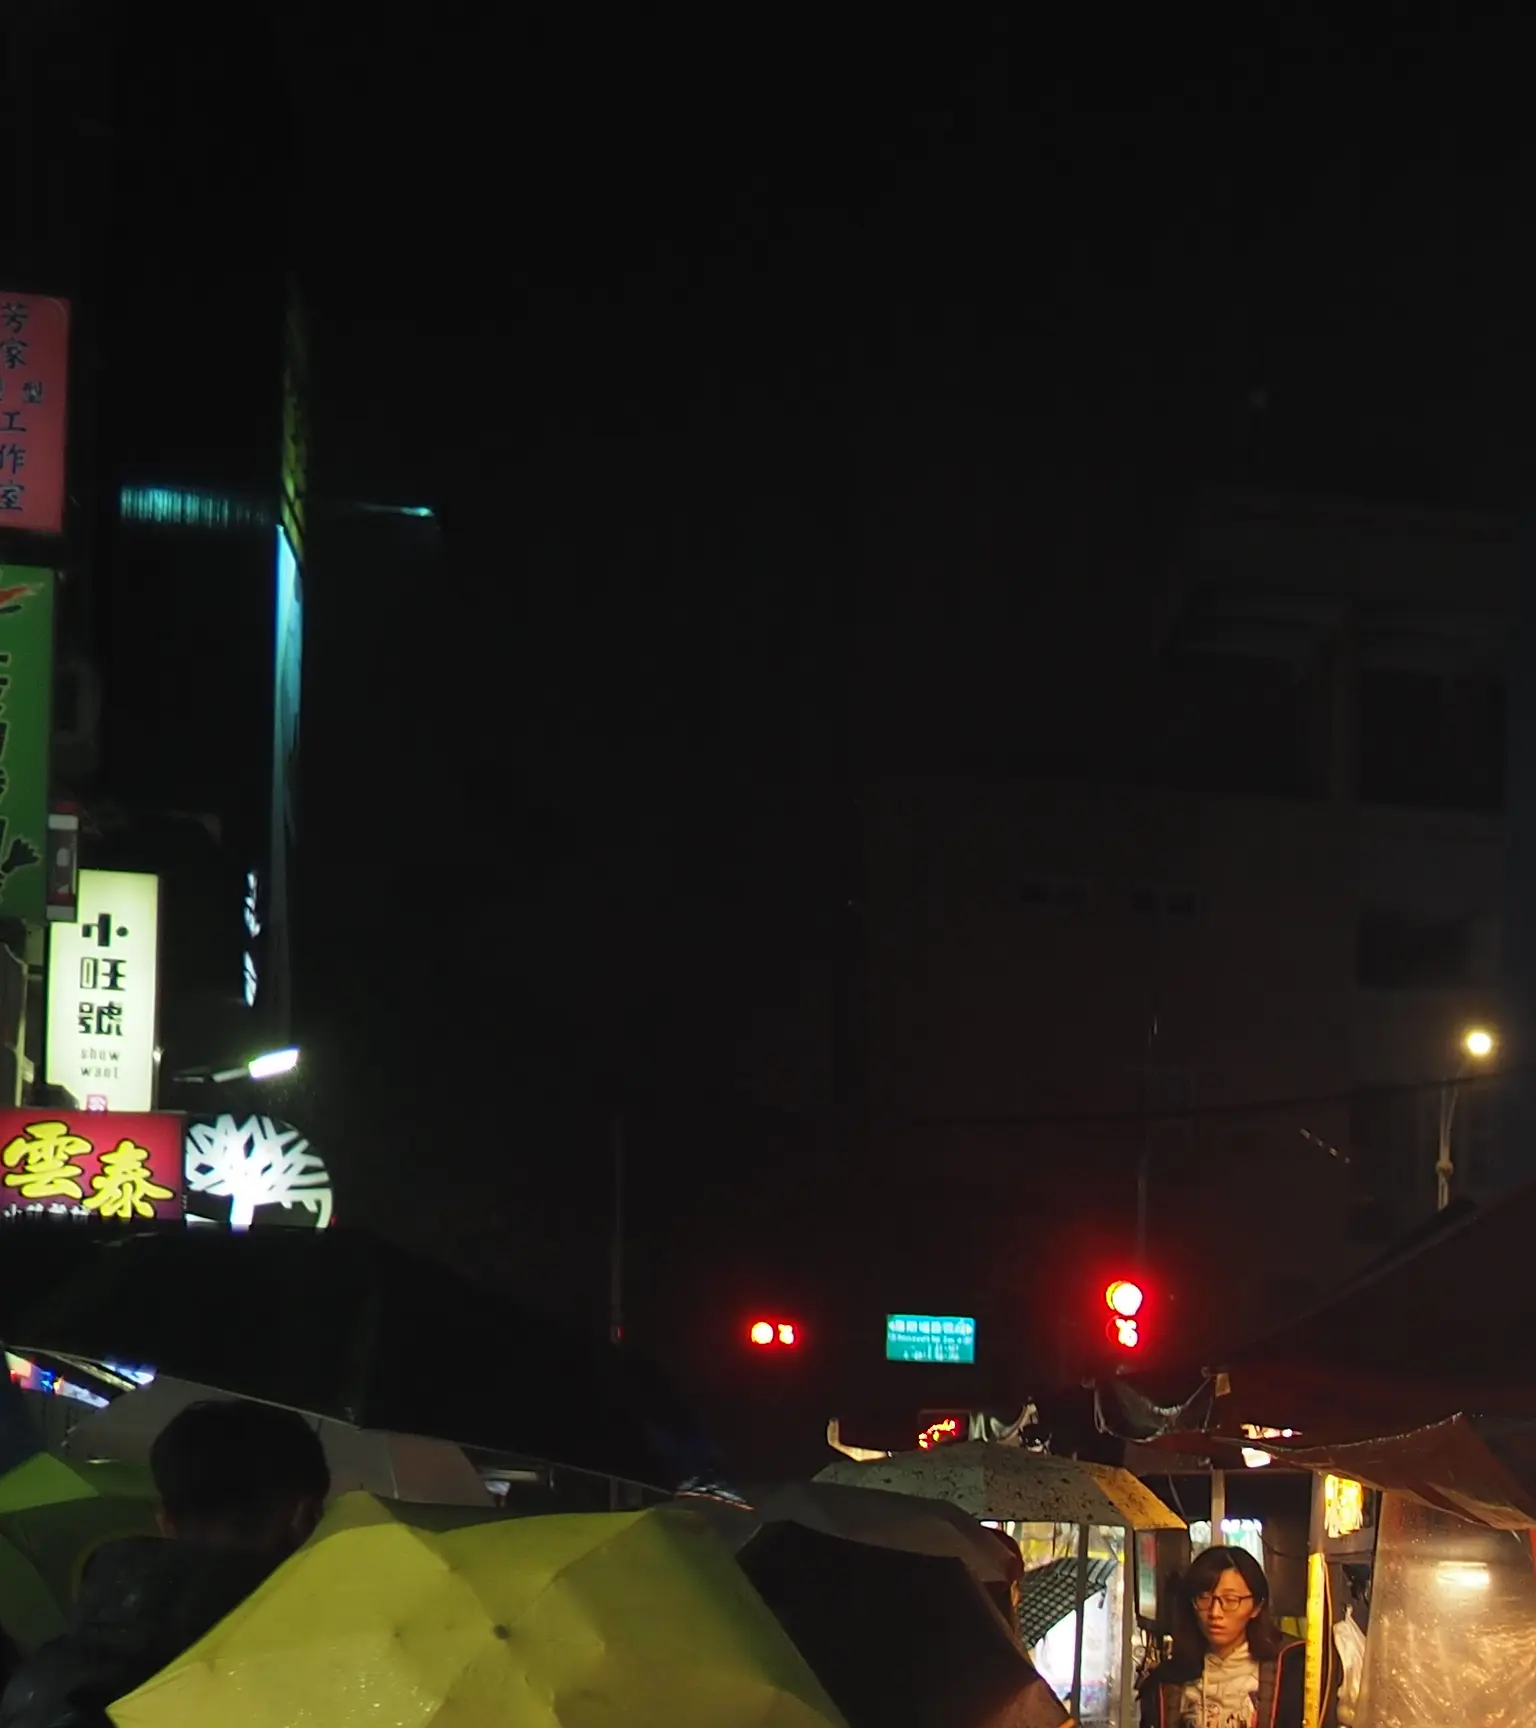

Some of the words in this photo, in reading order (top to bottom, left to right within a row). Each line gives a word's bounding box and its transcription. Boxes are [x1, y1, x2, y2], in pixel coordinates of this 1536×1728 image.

[79, 913, 130, 1038] 小旺號
[3, 1120, 175, 1219] 雲泰
